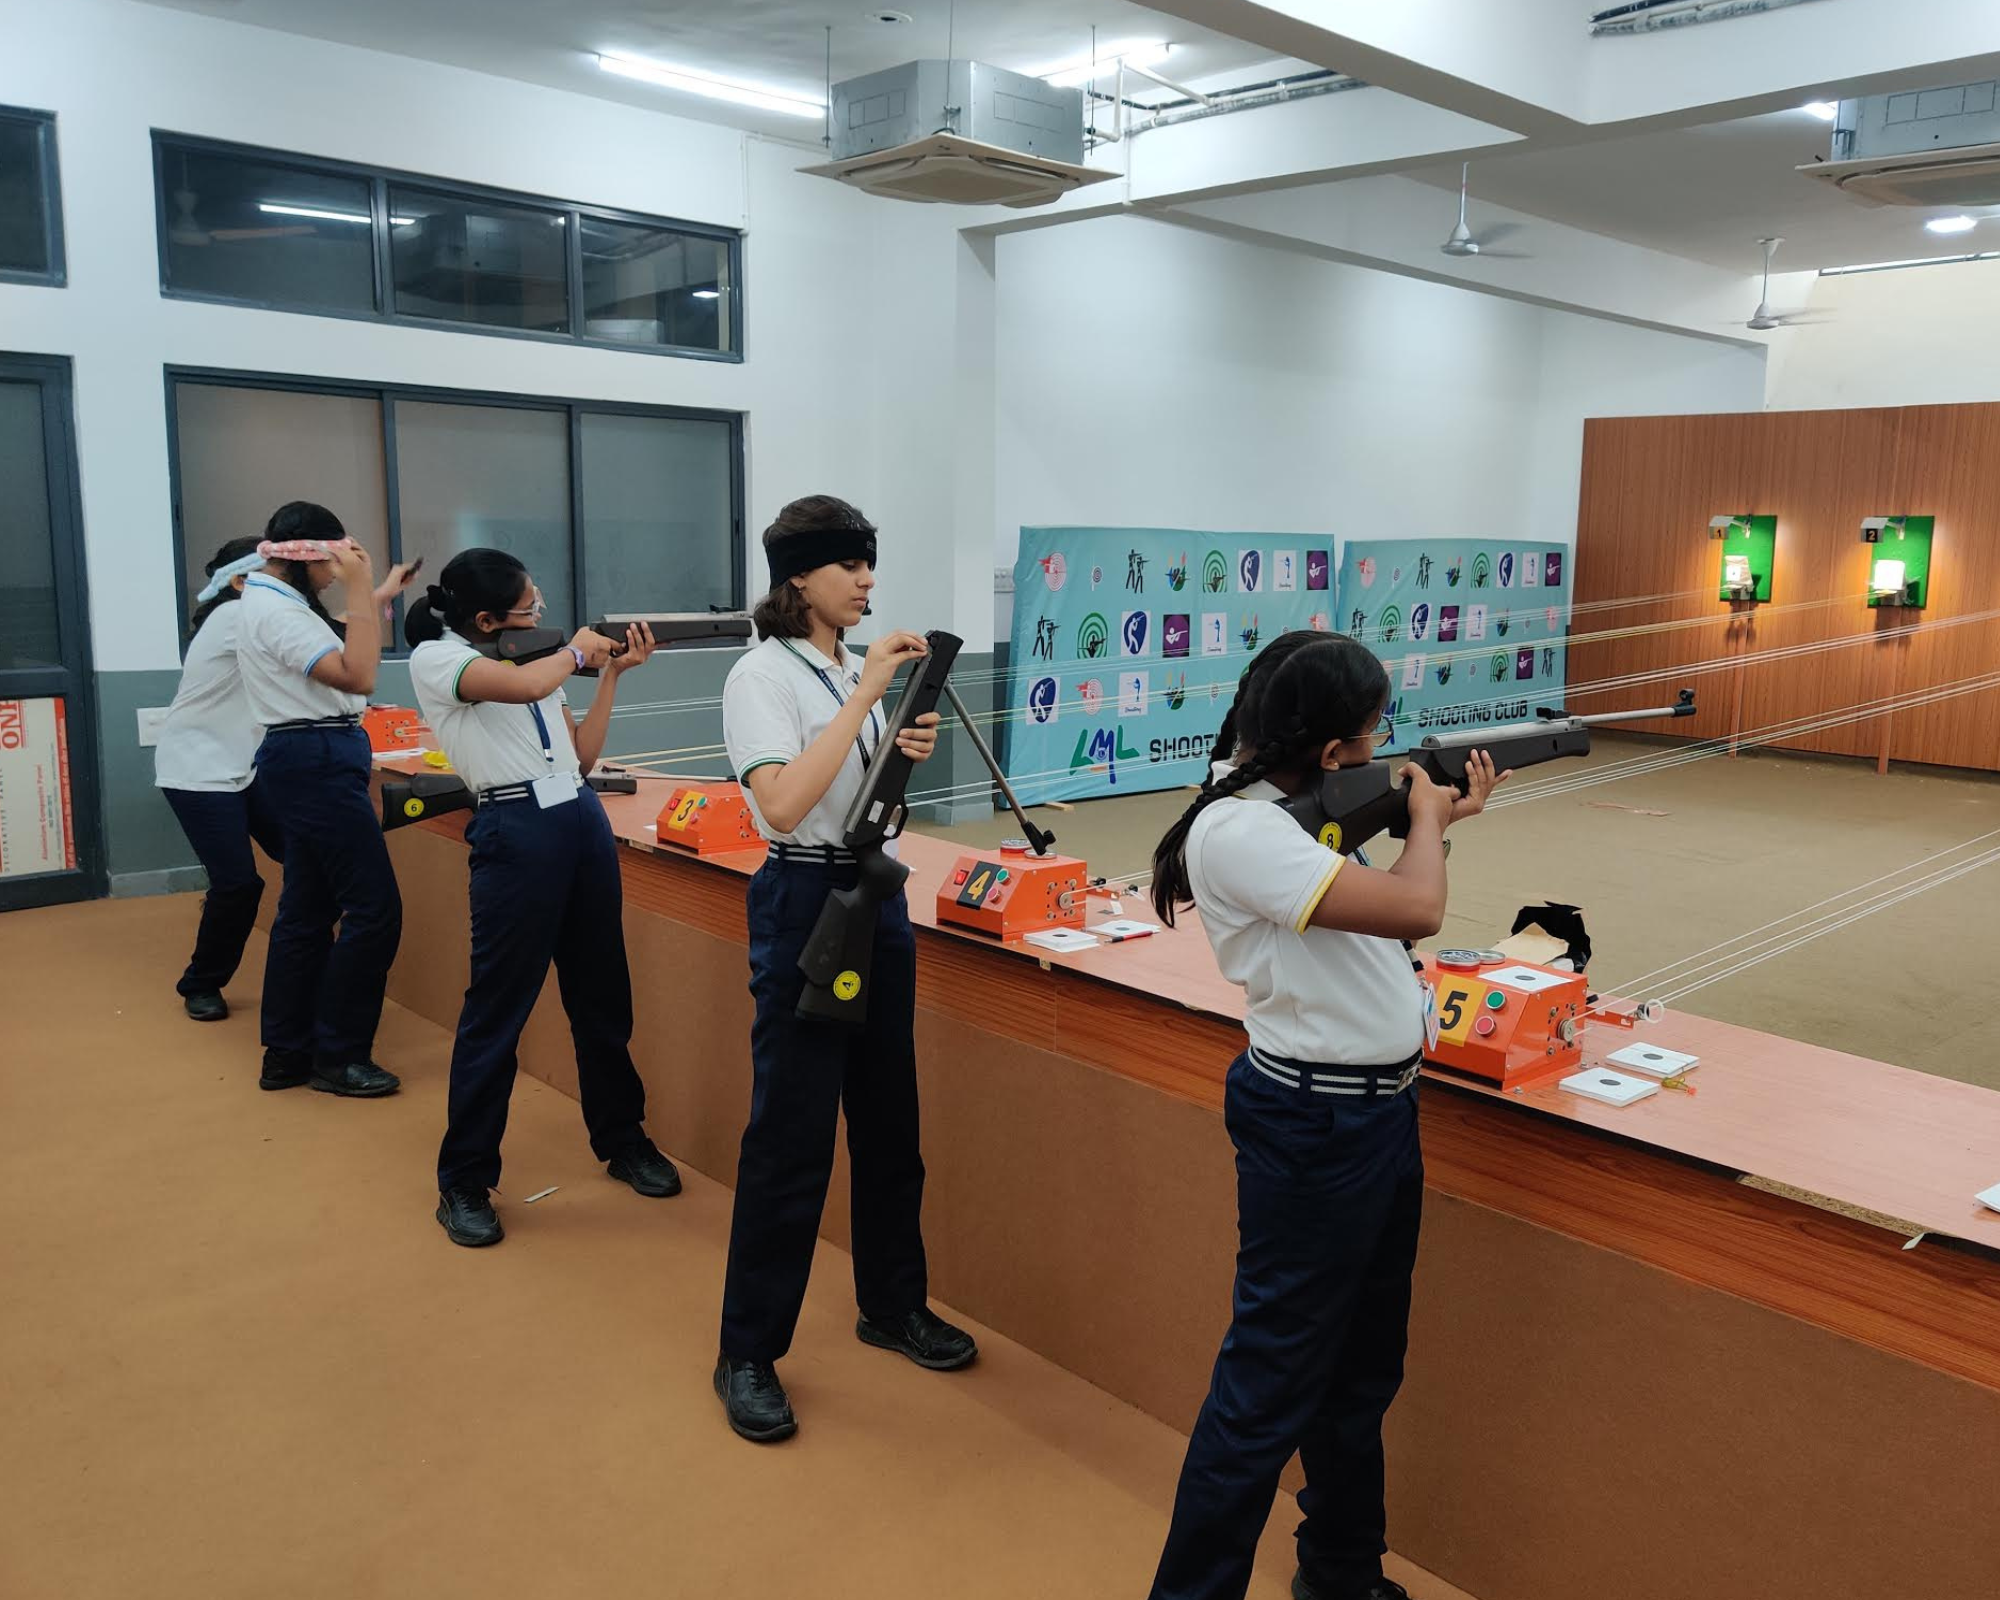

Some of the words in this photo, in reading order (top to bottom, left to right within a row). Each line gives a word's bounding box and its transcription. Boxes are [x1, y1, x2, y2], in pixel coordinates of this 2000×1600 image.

[1867, 530, 1876, 541] 2
[1418, 702, 1492, 728] SHOOTING
[1495, 700, 1528, 721] CLUB
[411, 803, 418, 812] 6
[677, 799, 694, 822] 3
[1327, 833, 1334, 850] 8
[967, 870, 991, 901] 4
[1440, 990, 1469, 1031] 5
